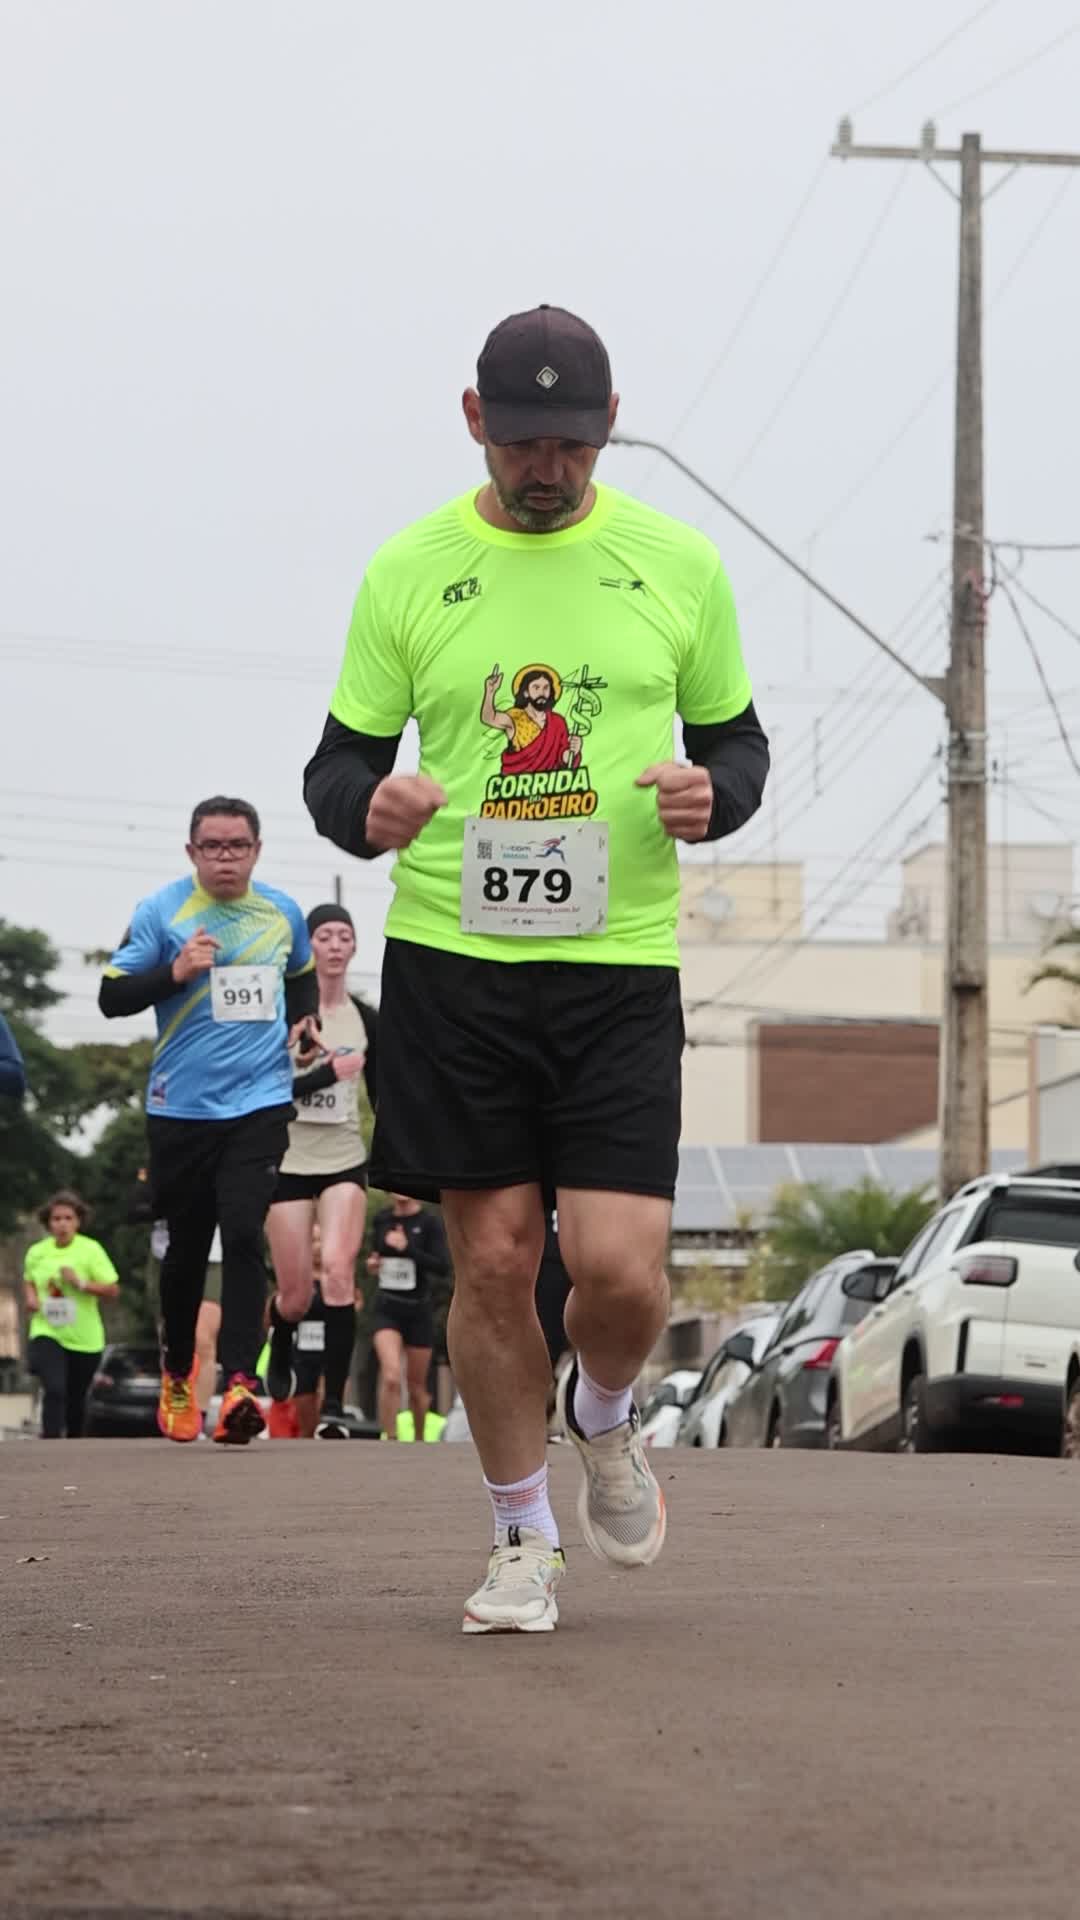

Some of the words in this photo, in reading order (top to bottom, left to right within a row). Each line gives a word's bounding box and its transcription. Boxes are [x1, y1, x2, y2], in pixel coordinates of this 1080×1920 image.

[486, 766, 590, 801] CORRIDA
[481, 790, 597, 820] PADROEIRO
[483, 866, 572, 904] 879
[223, 987, 263, 1006] 991
